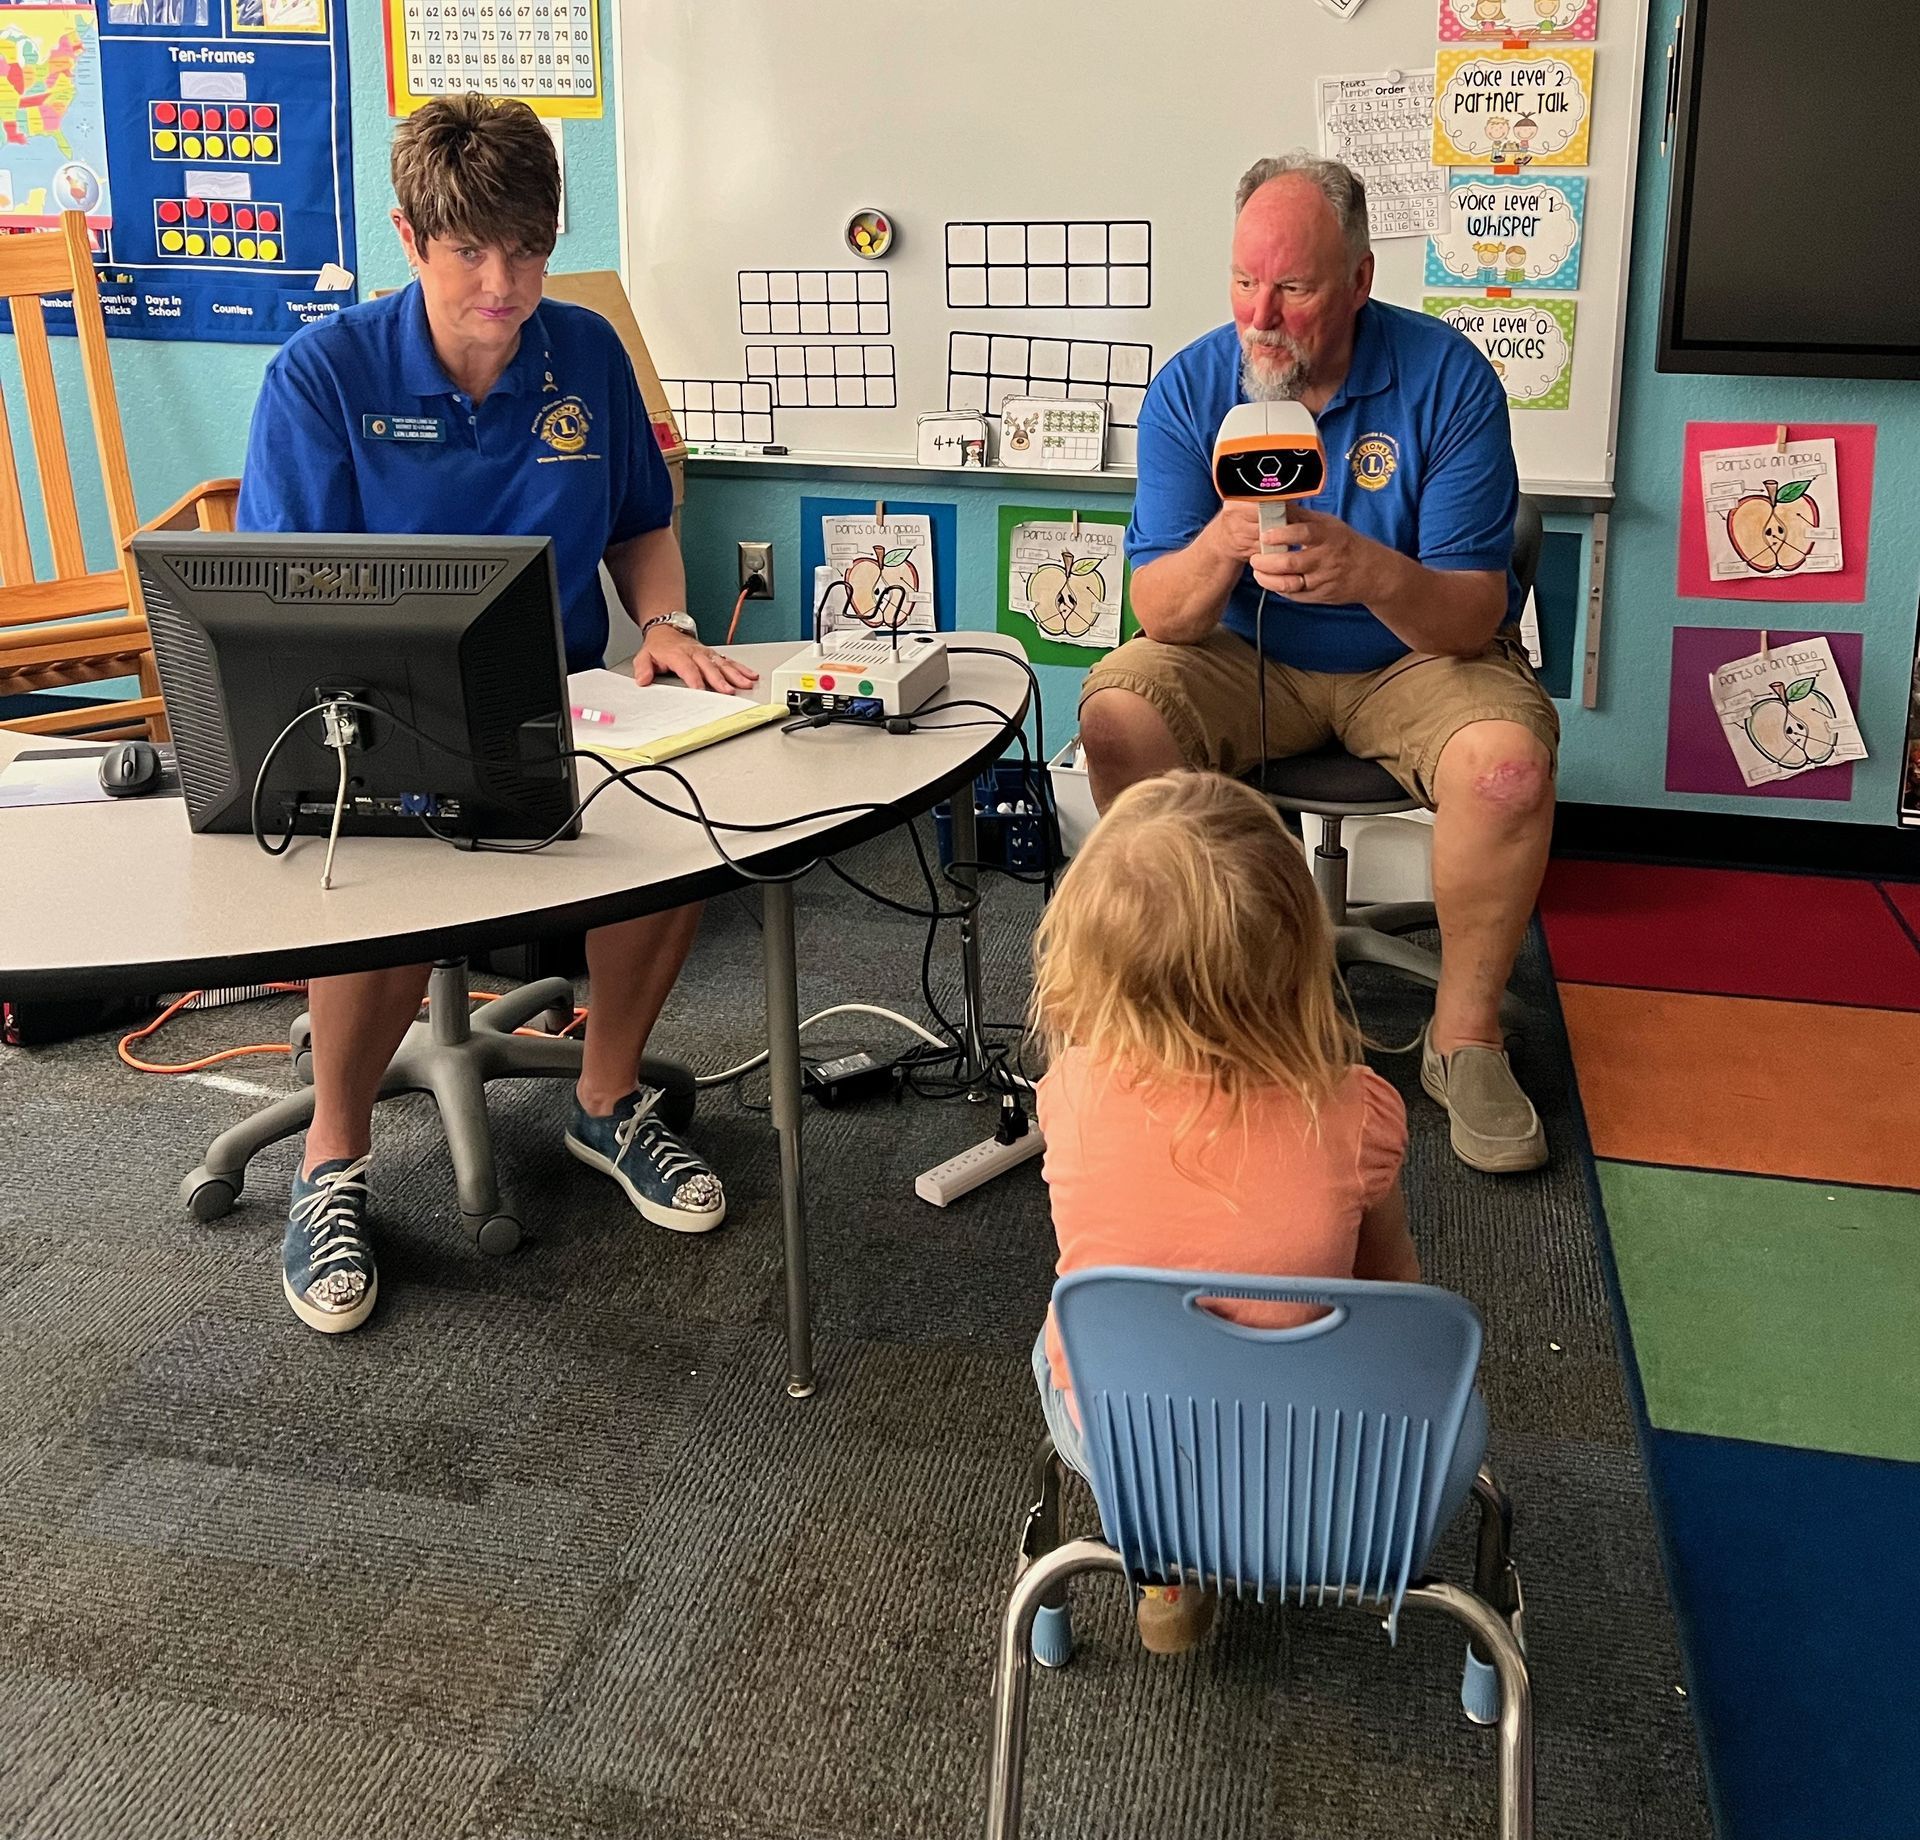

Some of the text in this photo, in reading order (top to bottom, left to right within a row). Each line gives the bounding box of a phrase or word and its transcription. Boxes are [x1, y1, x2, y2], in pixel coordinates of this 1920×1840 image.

[409, 6, 587, 17] 61 62 63 64 65 66 67 68 69 70
[410, 30, 588, 41] 71 72 73 74 75 76 77 78 79 80
[168, 46, 255, 64] Ten-Frames
[412, 54, 590, 65] 81 82 83 84 85 86 87 88 89 90
[413, 78, 592, 89] 91 92 93 94 95 96 97 98 99 100
[1555, 70, 1564, 87] 2
[1375, 86, 1405, 96] Order
[1350, 104, 1357, 112] 2
[1365, 102, 1372, 111] 3
[1381, 100, 1388, 109] 4
[1397, 98, 1406, 108] 5
[1413, 97, 1420, 106] 6
[1426, 97, 1434, 108] 7
[1345, 136, 1351, 146] 8
[1549, 196, 1554, 212] 1
[1397, 212, 1408, 220] 20
[1371, 224, 1378, 232] 8
[1385, 223, 1393, 231] 11
[145, 294, 182, 306] Days in
[104, 305, 131, 315] Sticks
[148, 307, 181, 316] School
[212, 303, 253, 316] Counters
[286, 301, 340, 311] Ten-Frame
[558, 418, 576, 435] L
[1360, 443, 1387, 454] LIONS
[1368, 456, 1380, 473] L
[289, 566, 380, 595] DELL
